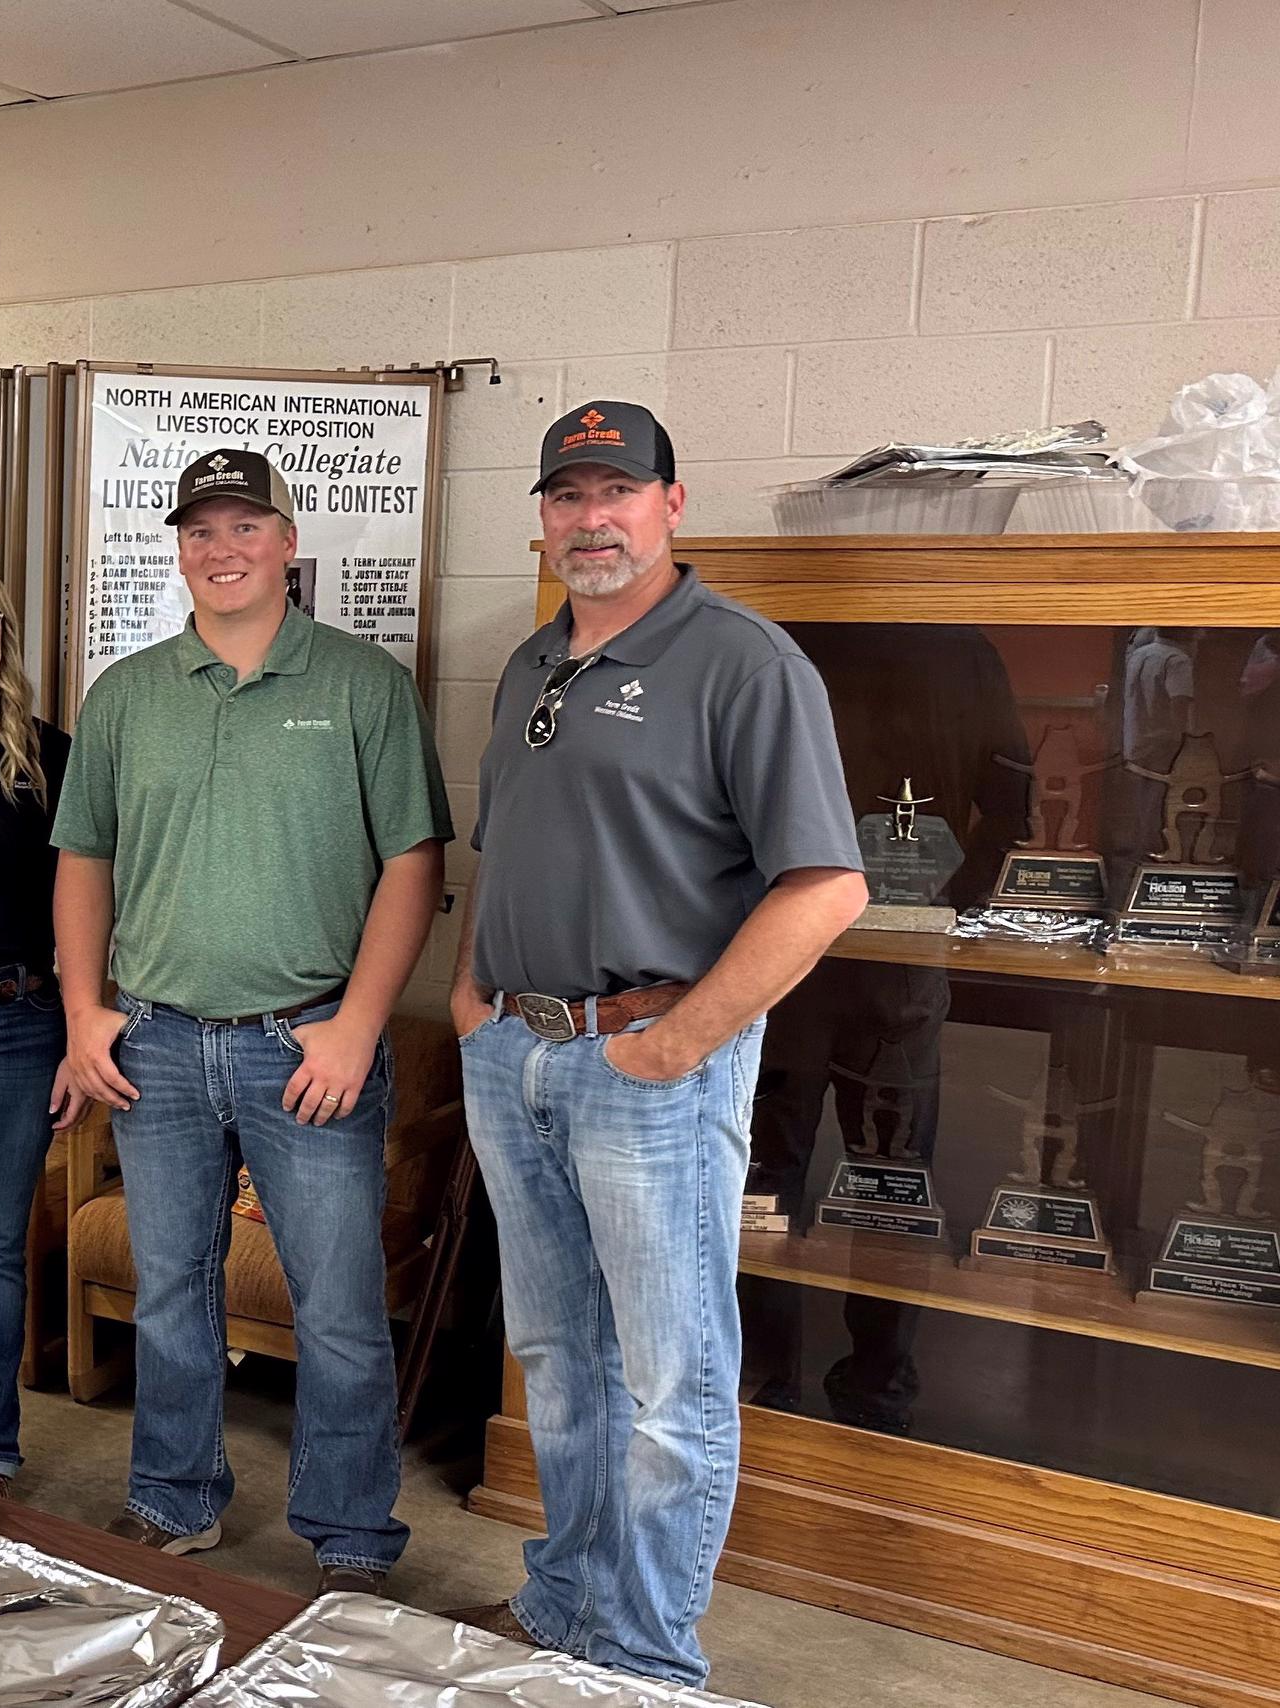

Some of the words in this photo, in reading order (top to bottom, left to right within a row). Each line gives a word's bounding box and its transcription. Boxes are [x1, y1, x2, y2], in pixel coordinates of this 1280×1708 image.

[106, 388, 172, 408] NORTH
[180, 391, 276, 412] AMERICAN
[284, 395, 422, 417] INTERNATIONAL
[156, 415, 259, 435] LIVESTOCK
[267, 418, 375, 439] EXPOSITION
[262, 442, 402, 480] Collegiate
[216, 470, 244, 481] Credit
[327, 485, 418, 514] CONTEST
[104, 532, 121, 544] Left
[124, 533, 133, 543] to
[136, 532, 162, 545] Right:
[100, 555, 115, 565] DR.
[139, 556, 174, 566] WAGNER
[353, 558, 377, 567] TERRY
[379, 559, 417, 567] LOCKHART
[102, 568, 127, 578] ADAM
[355, 571, 382, 580] JUSTIN
[385, 571, 409, 580] STACY
[101, 581, 131, 591] GRANT
[133, 581, 166, 591] TURNER
[353, 583, 378, 592] SCOTT
[380, 583, 408, 592] STEDJE
[101, 594, 129, 604] CASEY
[132, 594, 155, 604] MEEK
[354, 596, 374, 604] CODY
[377, 596, 407, 604] SANKEY
[101, 607, 132, 617] MARTY
[387, 608, 416, 617] JOHNSON
[353, 620, 377, 629] COACH
[99, 632, 126, 642] HEATH
[381, 634, 415, 643] CANTRELL
[99, 645, 132, 656] JEREMY
